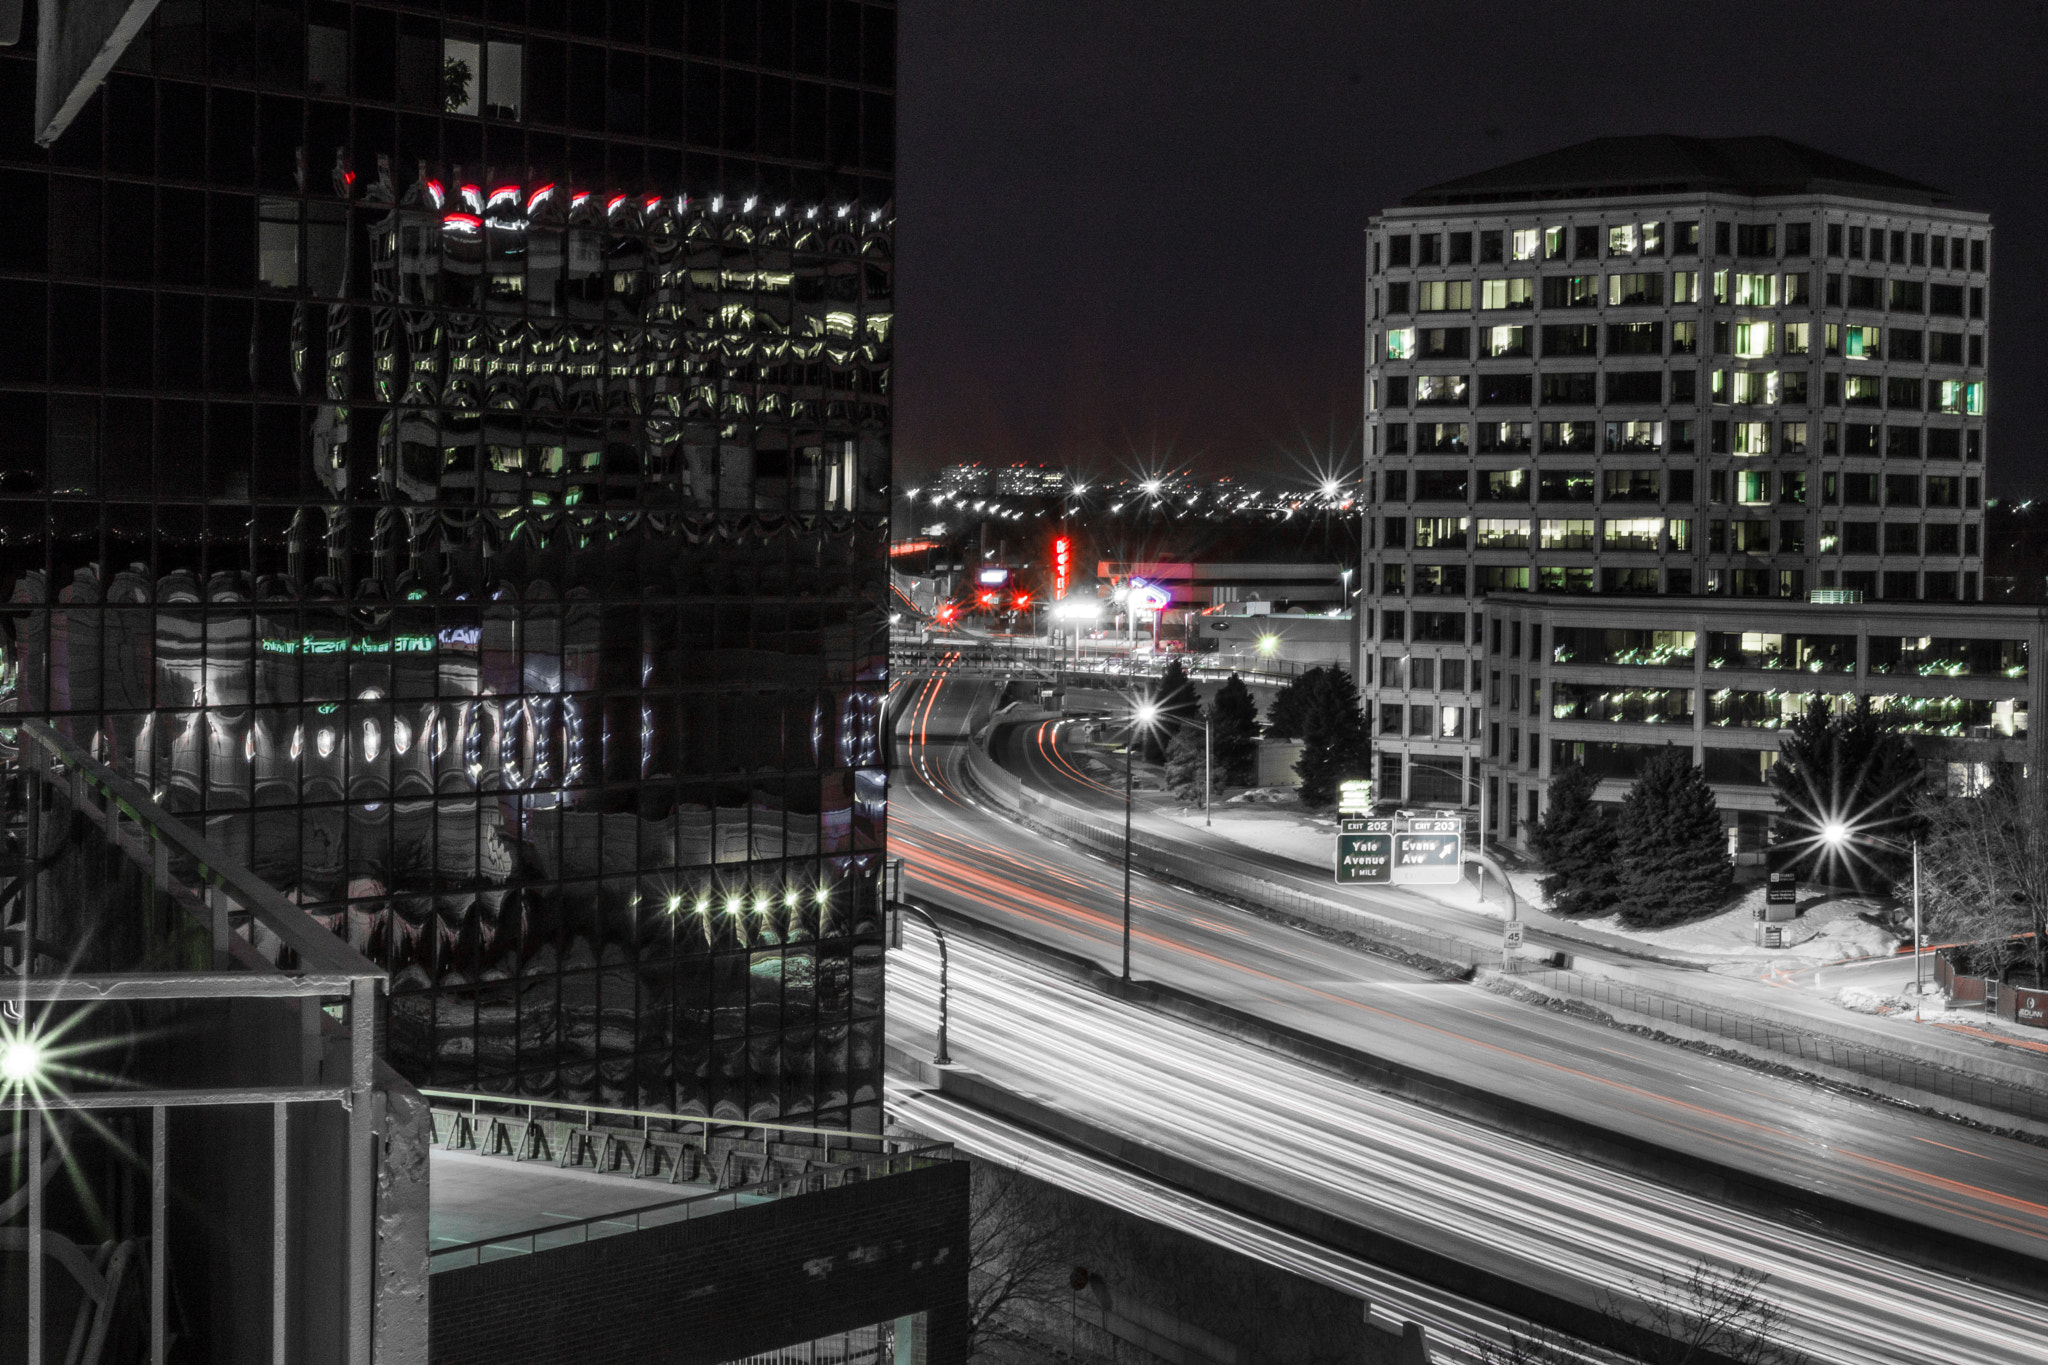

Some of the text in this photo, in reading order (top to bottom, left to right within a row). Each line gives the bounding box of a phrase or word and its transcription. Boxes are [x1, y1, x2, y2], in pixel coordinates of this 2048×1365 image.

[1347, 821, 1388, 831] EXIT 202
[1414, 821, 1455, 831] EXIT 203
[1352, 841, 1378, 852] Yale
[1401, 840, 1436, 851] Evans
[1343, 855, 1385, 865] Avenue
[1401, 854, 1424, 864] Ave
[1350, 868, 1356, 878] 1
[1507, 932, 1520, 942] 45
